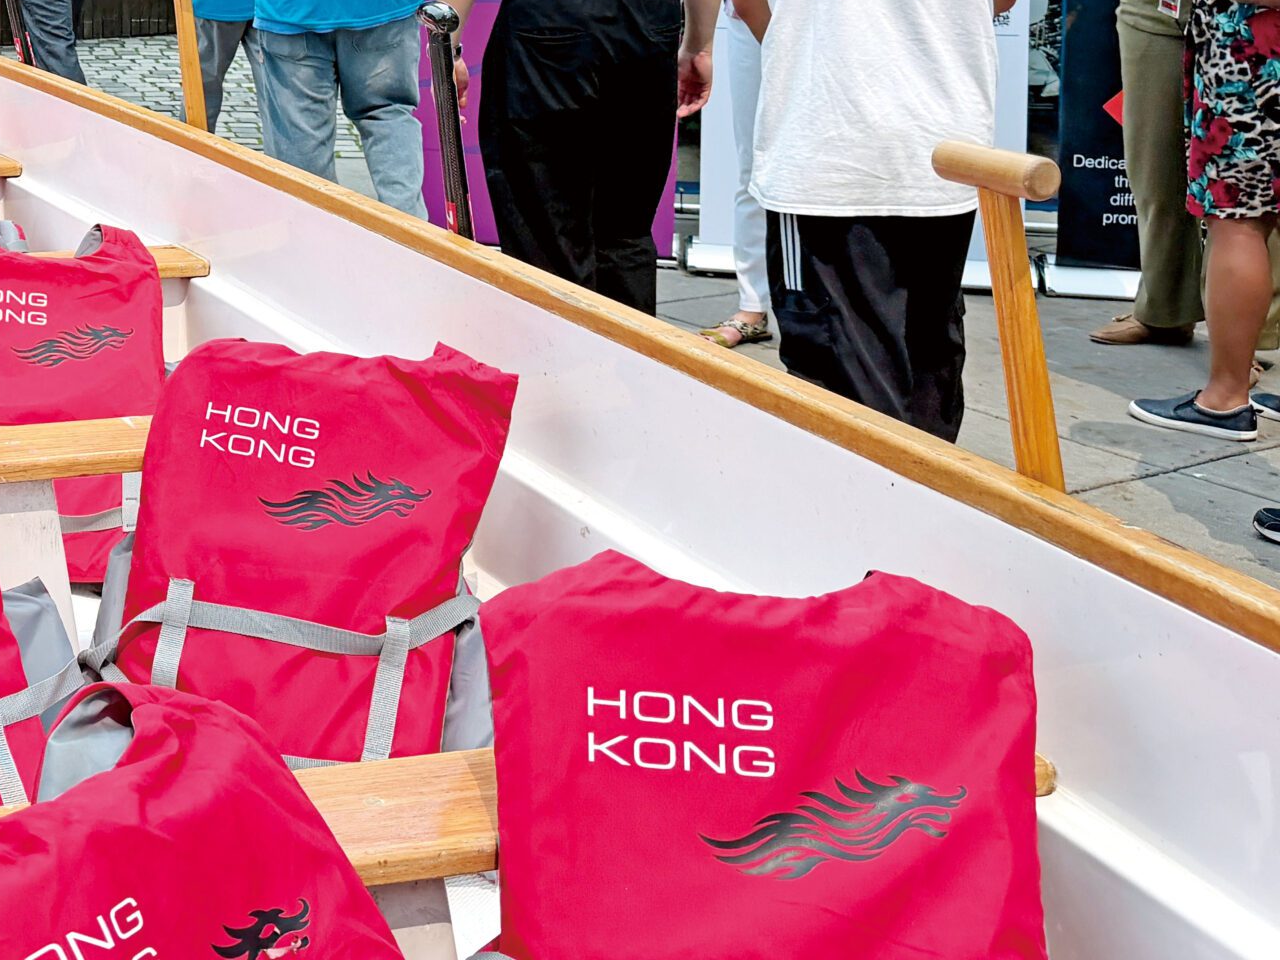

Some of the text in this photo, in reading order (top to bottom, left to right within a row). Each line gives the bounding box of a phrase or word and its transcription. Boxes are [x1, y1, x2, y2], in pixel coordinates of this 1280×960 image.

[1109, 193, 1136, 206] diff
[205, 401, 320, 440] HONG
[199, 428, 316, 469] KONG
[587, 686, 774, 731] HONG
[587, 731, 776, 778] KONG
